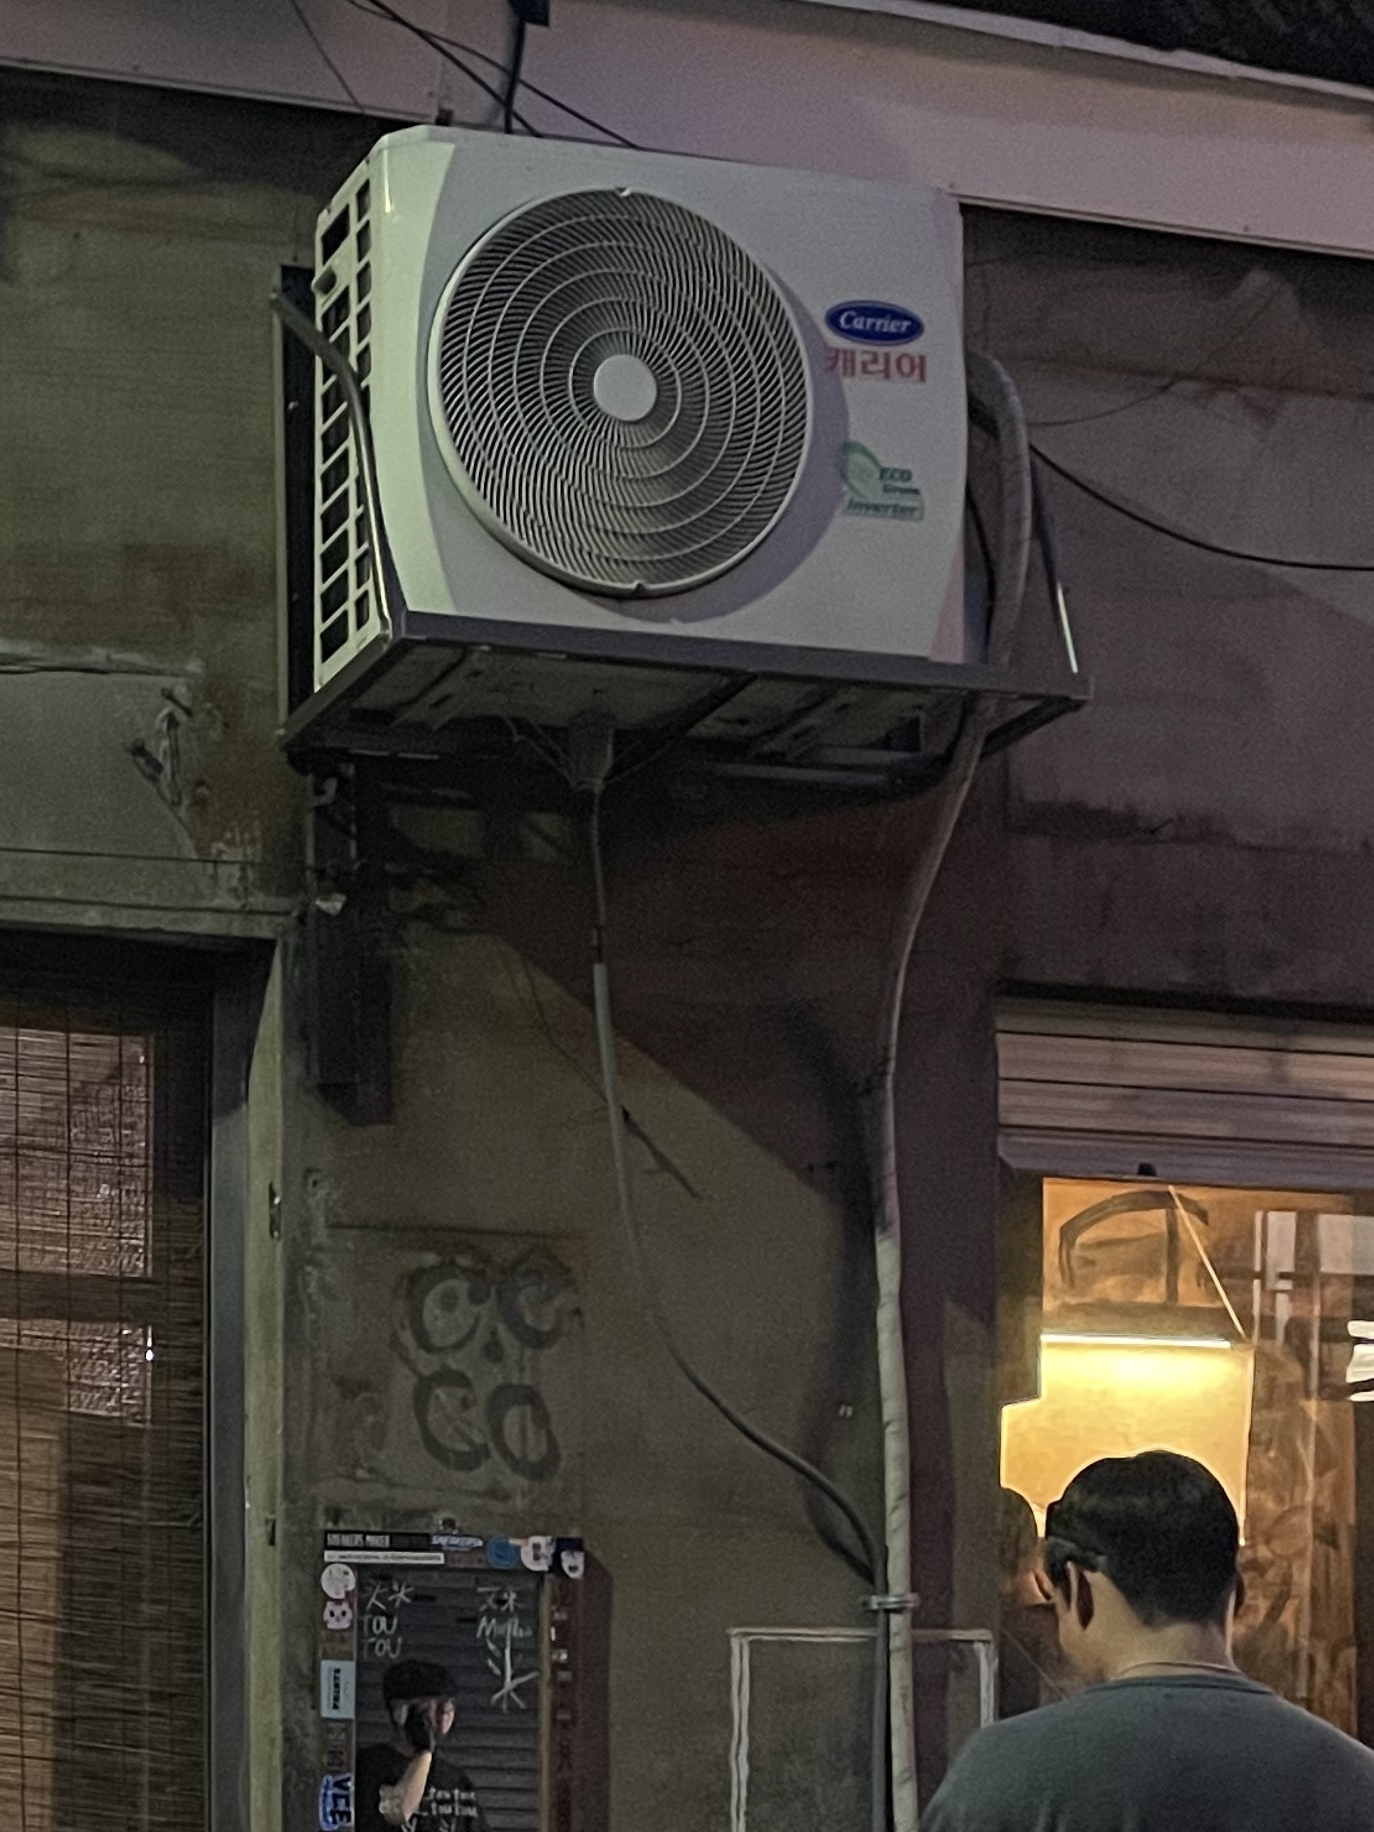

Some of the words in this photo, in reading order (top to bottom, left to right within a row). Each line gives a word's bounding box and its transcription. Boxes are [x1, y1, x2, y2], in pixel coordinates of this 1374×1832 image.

[838, 310, 912, 333] Carrier
[824, 347, 927, 384] 캐리어
[879, 466, 913, 482] ECO
[846, 497, 920, 518] Inverter
